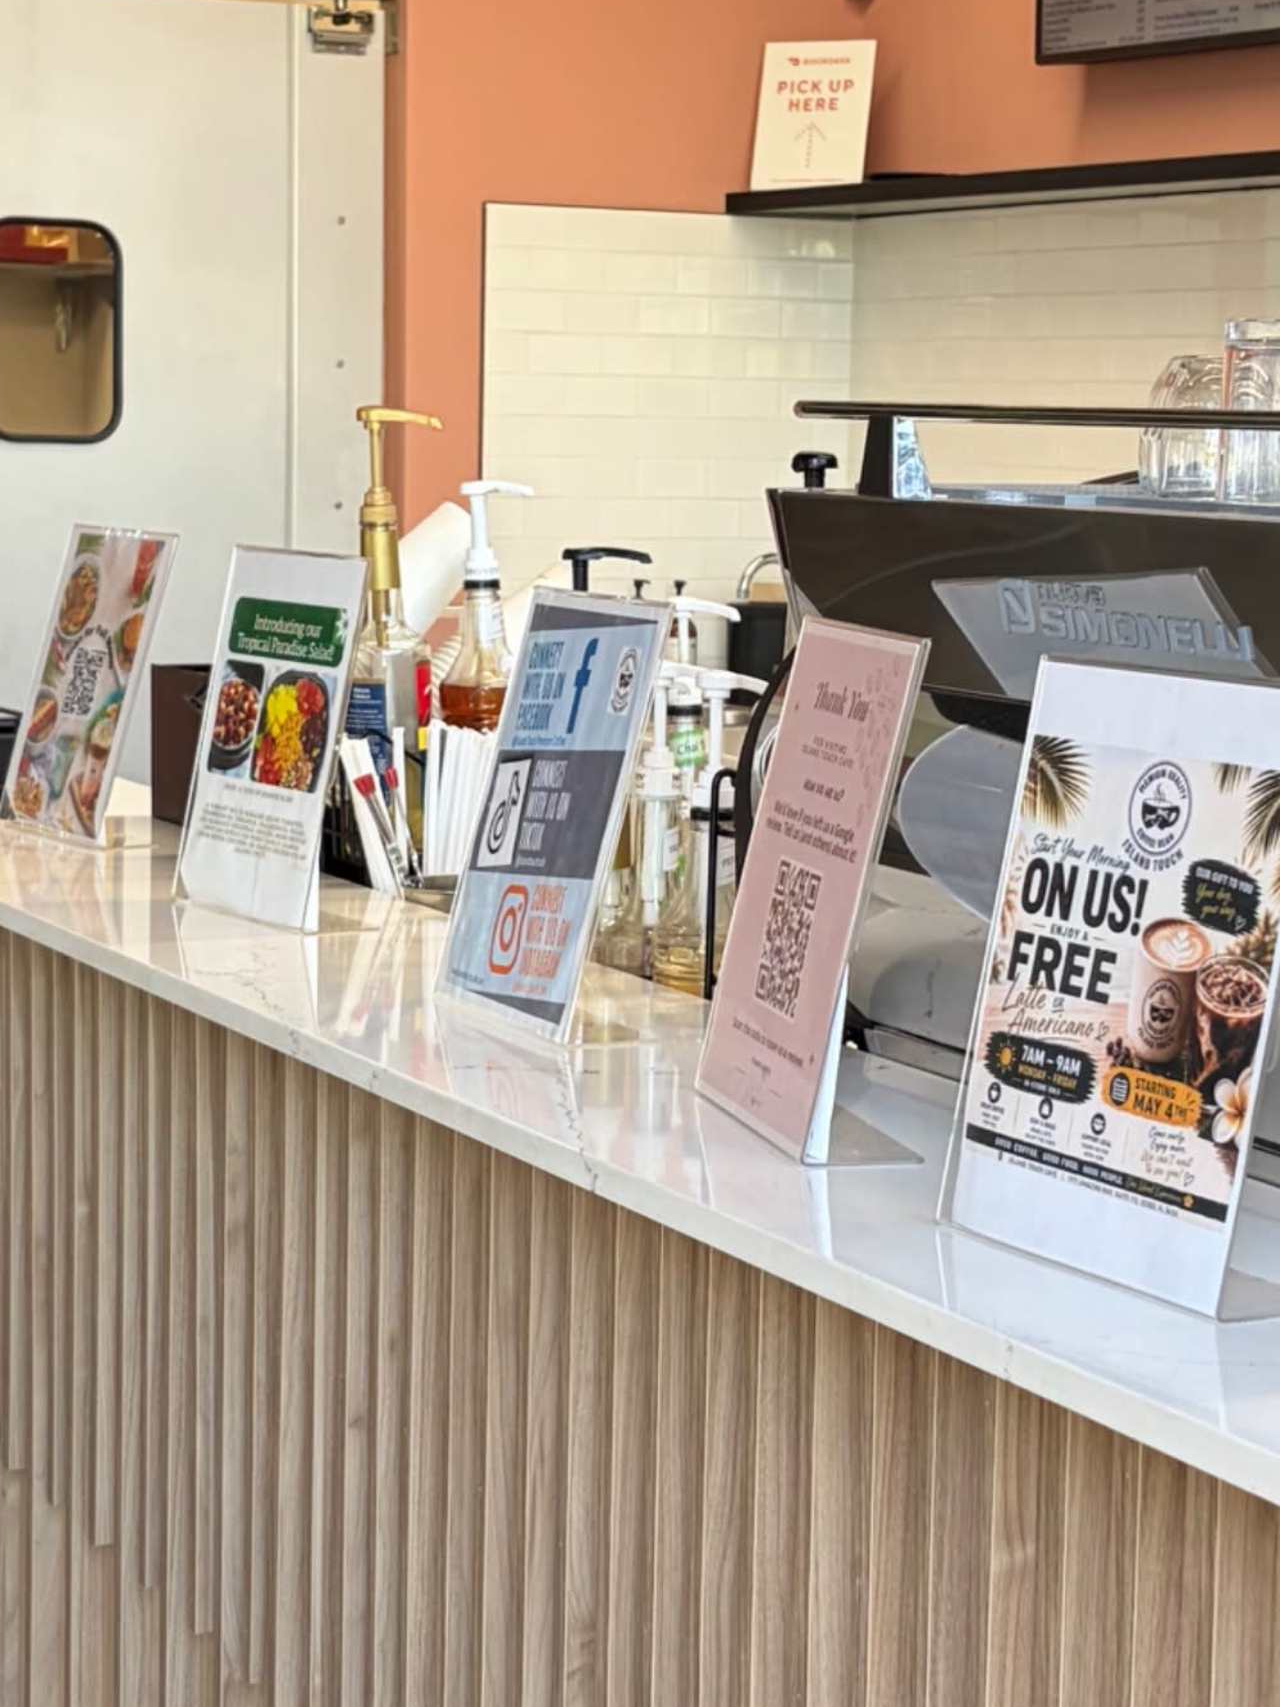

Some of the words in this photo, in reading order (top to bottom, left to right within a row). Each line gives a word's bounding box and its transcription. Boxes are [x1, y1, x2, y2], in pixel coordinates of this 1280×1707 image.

[777, 80, 821, 94] PICK
[828, 79, 854, 94] UP
[788, 97, 839, 112] HERE
[254, 613, 303, 638] Introducing
[306, 623, 322, 639] our
[237, 631, 270, 654] Tropical
[271, 636, 307, 655] Paradise
[309, 641, 336, 661] Salad!
[814, 681, 848, 716] Thank
[848, 691, 870, 722] You
[1139, 769, 1167, 794] PREMIUM
[1167, 769, 1187, 799] QUALITY
[1031, 833, 1060, 856] Start
[1059, 836, 1085, 865] Your
[1087, 844, 1131, 873] Morning
[1122, 838, 1151, 871] ISLAND
[1152, 848, 1184, 872] TOUCH
[1021, 857, 1079, 921] ON
[1082, 868, 1149, 936] US!
[1211, 871, 1227, 884] GIFT
[1228, 875, 1237, 888] TO
[1238, 879, 1254, 895] YOU
[1050, 925, 1078, 939] ENJOY
[1081, 930, 1089, 941] A
[1007, 929, 1117, 1004] FREE
[1002, 971, 1047, 1012] Latte
[1008, 1011, 1095, 1037] Americano
[1021, 1045, 1046, 1065] 7AM
[1056, 1056, 1082, 1075] 9AM
[1018, 1063, 1046, 1080] MONDAY
[1053, 1073, 1078, 1090] FRIDAY
[1135, 1077, 1176, 1099] STARTING
[1135, 1095, 1162, 1115] MAY
